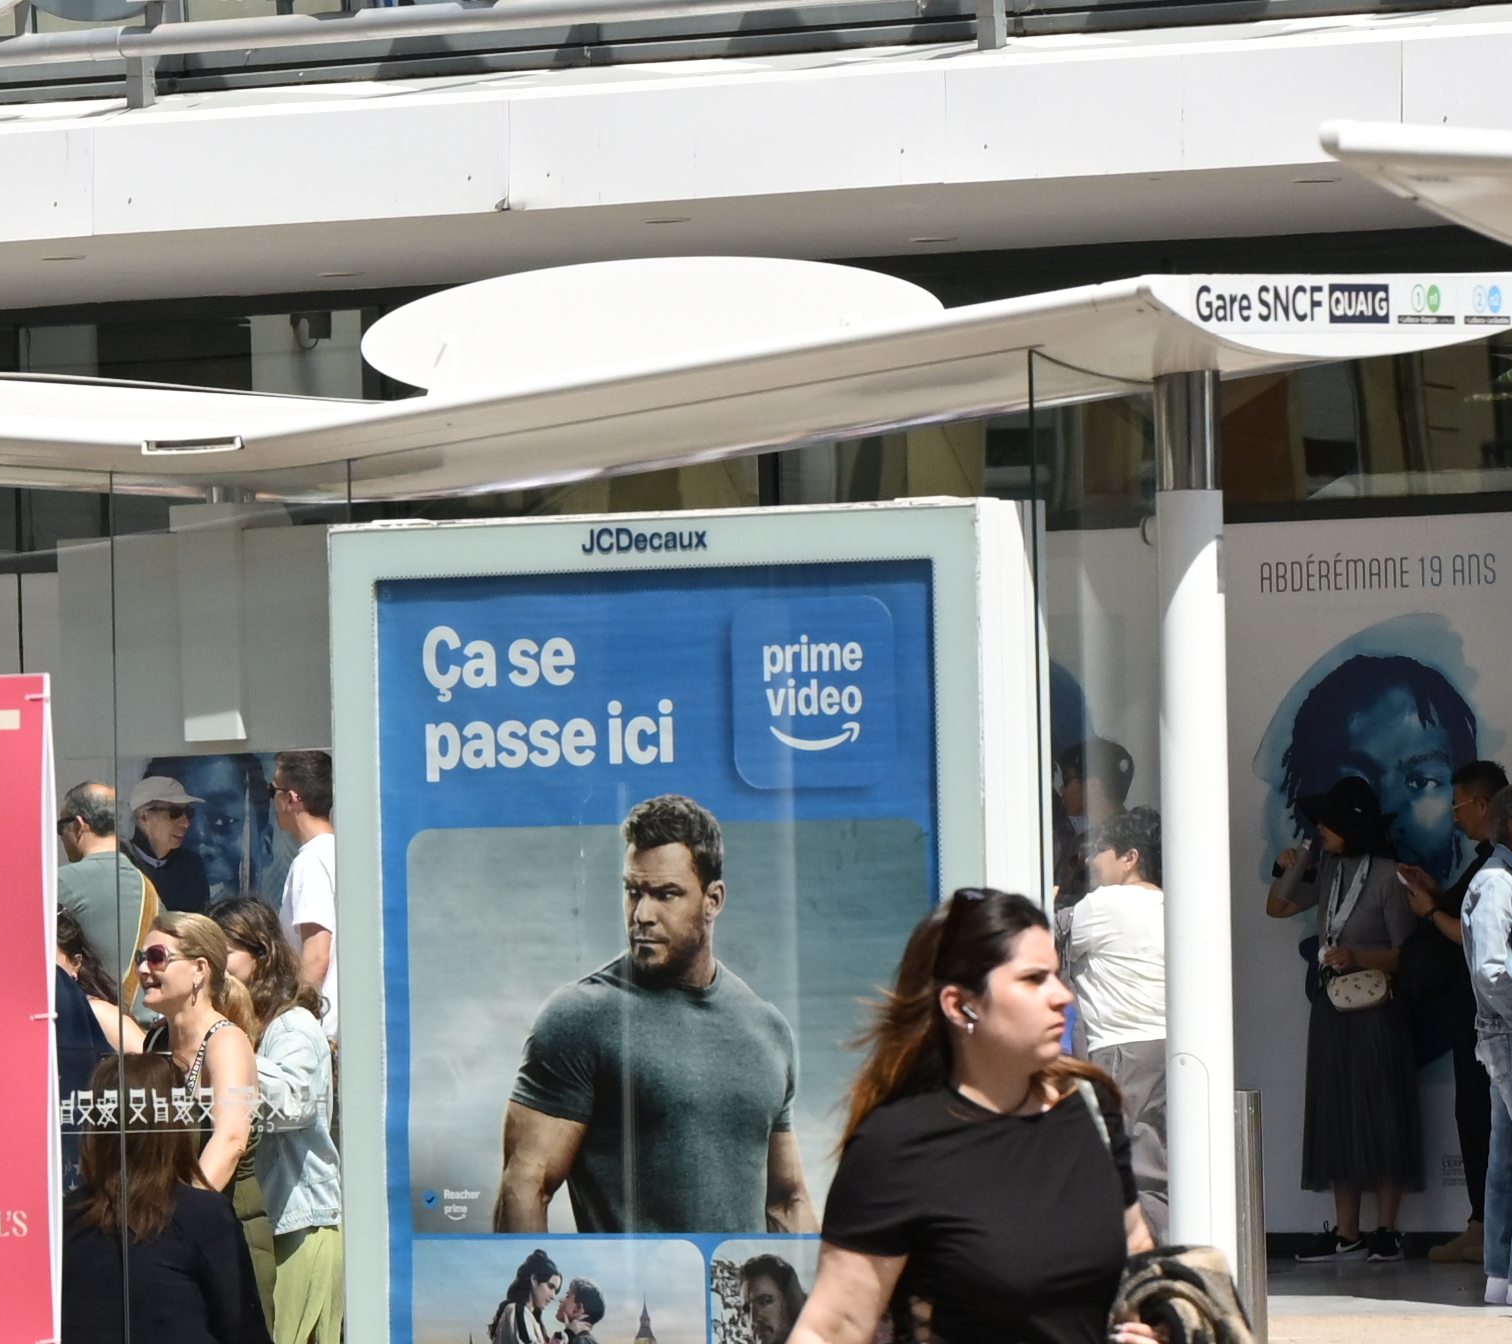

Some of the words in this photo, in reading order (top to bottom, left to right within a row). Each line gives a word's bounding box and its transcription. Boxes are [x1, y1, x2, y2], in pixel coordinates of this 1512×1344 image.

[1195, 283, 1253, 323] Gare
[1258, 284, 1324, 323] SNCF
[1330, 289, 1372, 319] QUAI
[1374, 290, 1388, 317] G
[581, 527, 707, 556] JCDecaux
[1259, 551, 1409, 594] ABDÉRÉMANE
[1418, 556, 1444, 588] 19
[1452, 552, 1497, 587] ANS
[423, 625, 496, 703] Ça
[508, 635, 575, 688] se
[762, 635, 863, 683] prime
[765, 680, 863, 718] video
[425, 719, 595, 784] passe
[607, 699, 675, 766] ici
[443, 1188, 481, 1200] Reacher
[444, 1204, 468, 1216] prime
